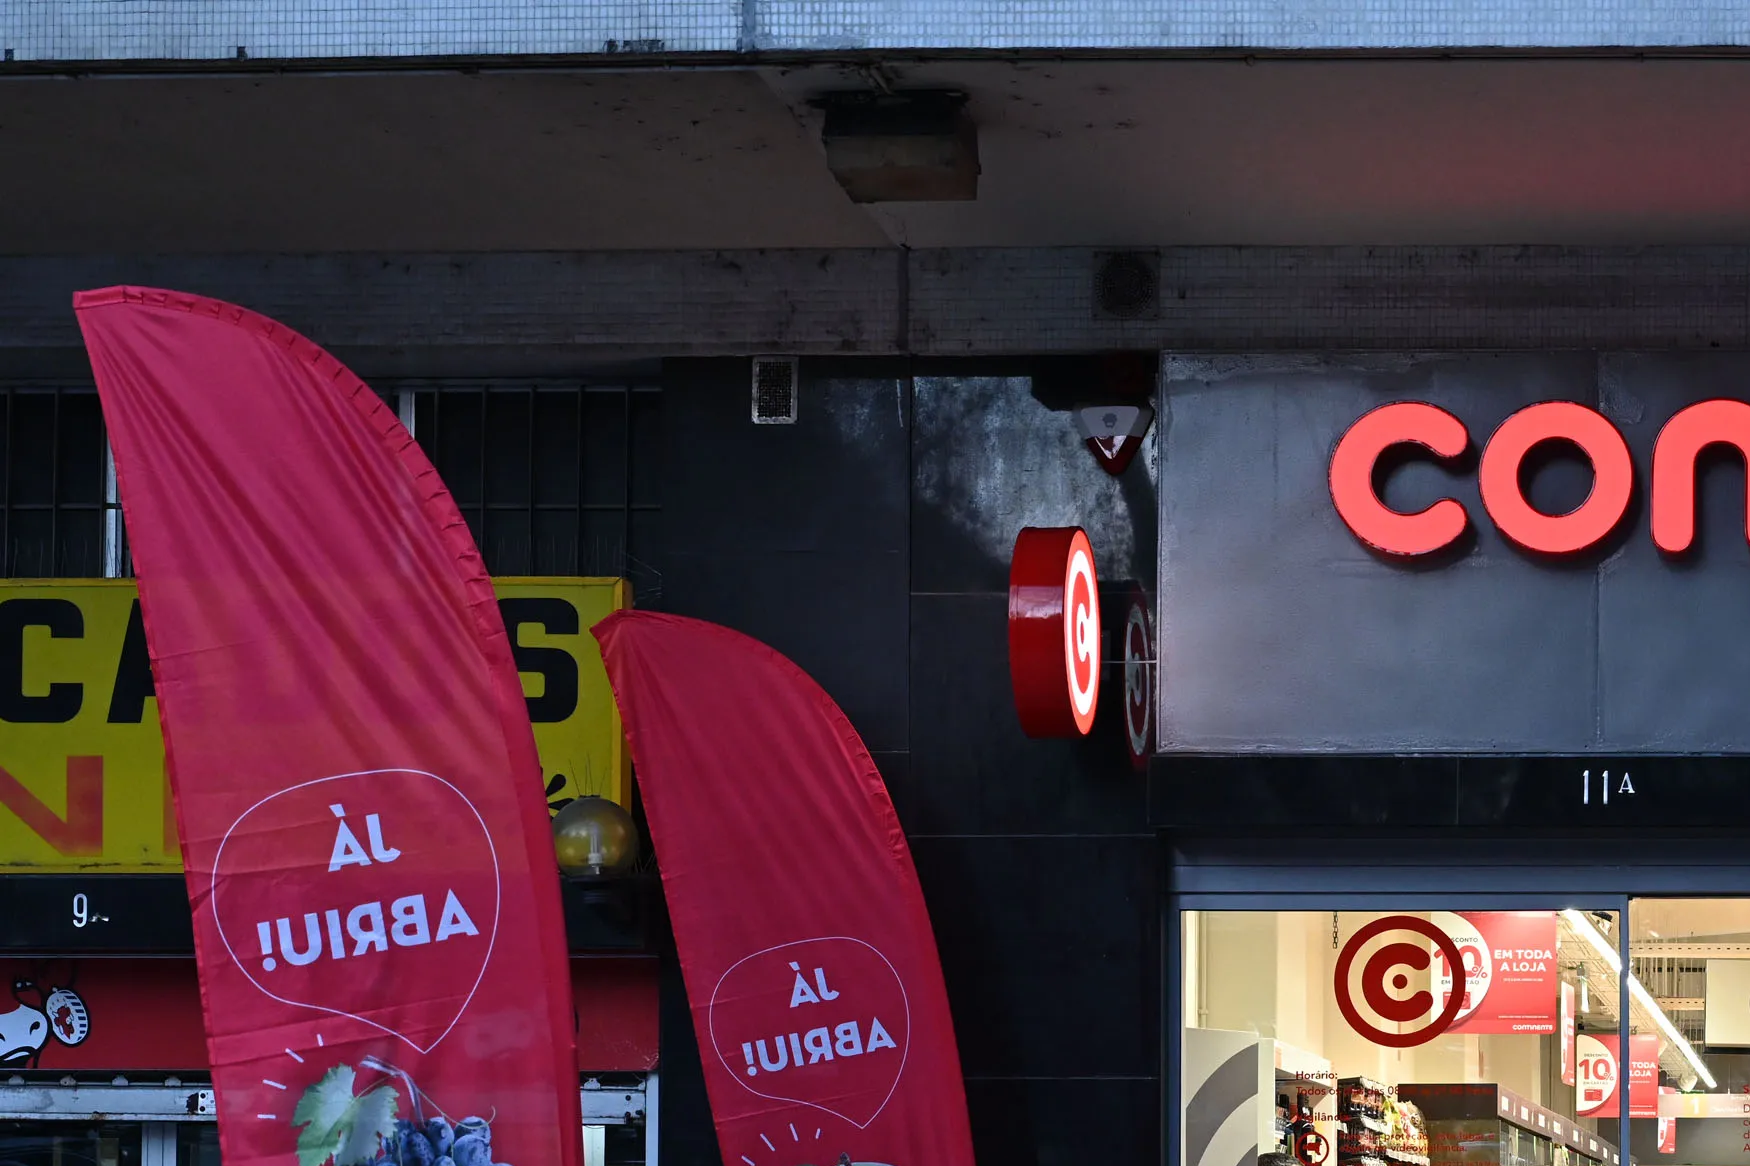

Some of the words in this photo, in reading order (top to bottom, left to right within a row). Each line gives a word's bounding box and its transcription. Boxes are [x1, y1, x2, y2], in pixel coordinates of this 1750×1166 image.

[72, 893, 88, 927] 9
[1494, 949, 1514, 960] EM
[1516, 949, 1553, 960] TODA
[1500, 961, 1510, 972] A
[1513, 961, 1546, 973] LOJA
[1632, 1061, 1656, 1069] TODA
[1296, 1071, 1338, 1081] Horário:
[1296, 1086, 1326, 1096] Todos
